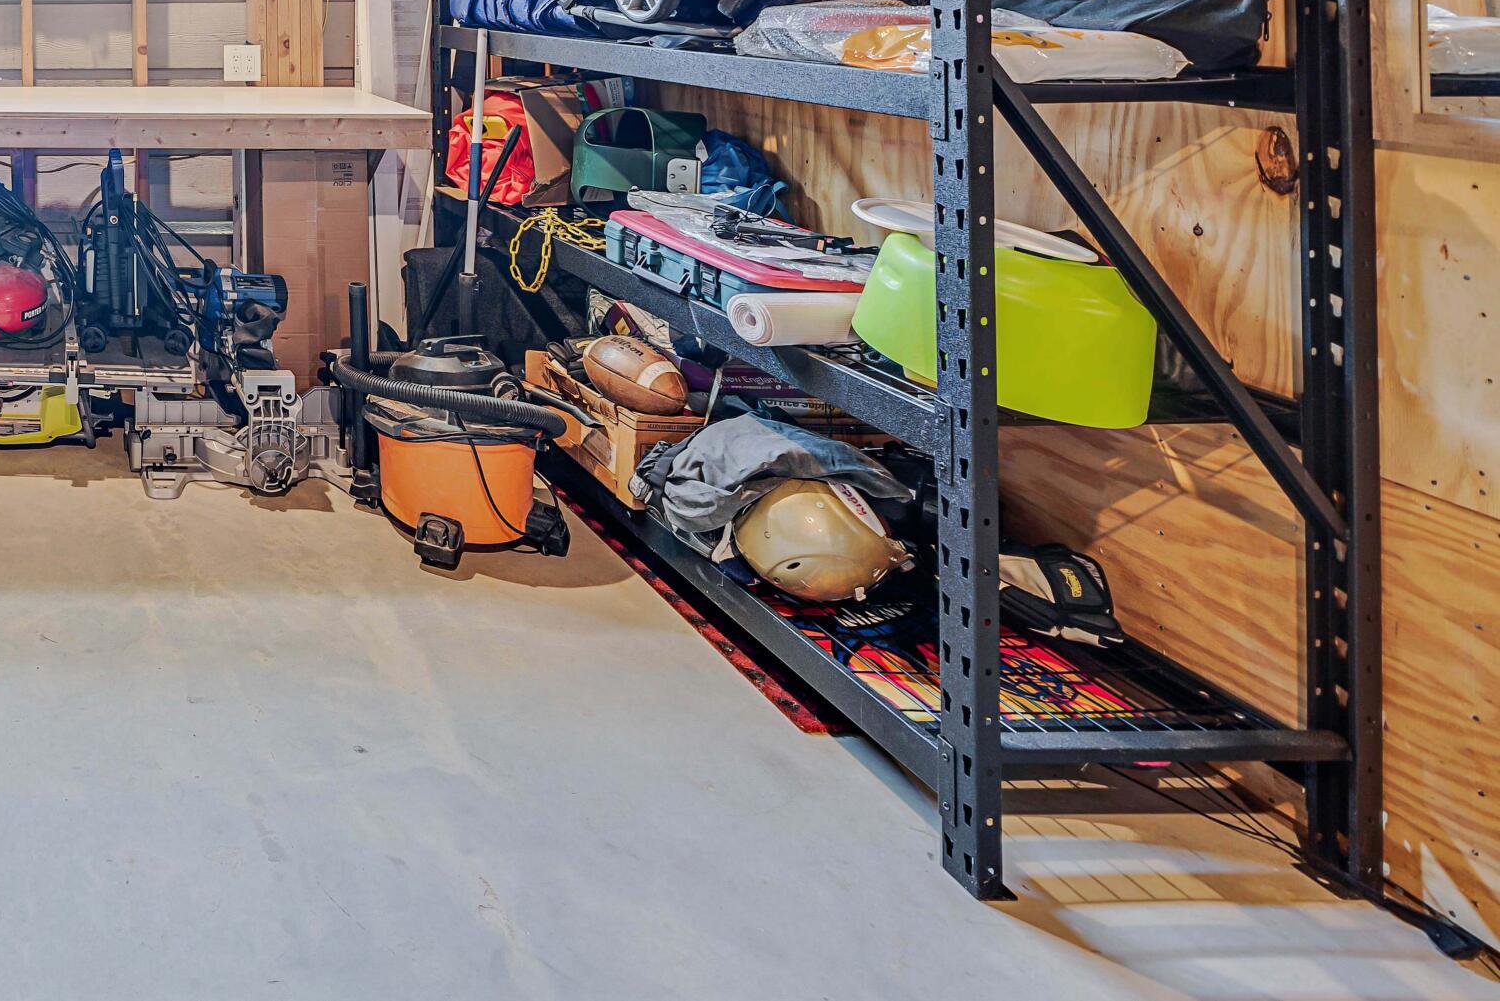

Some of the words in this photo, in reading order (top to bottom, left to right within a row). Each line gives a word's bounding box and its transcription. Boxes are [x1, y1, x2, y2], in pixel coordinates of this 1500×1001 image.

[610, 336, 645, 357] Wilson
[741, 375, 782, 385] England
[840, 483, 867, 516] Ridd
